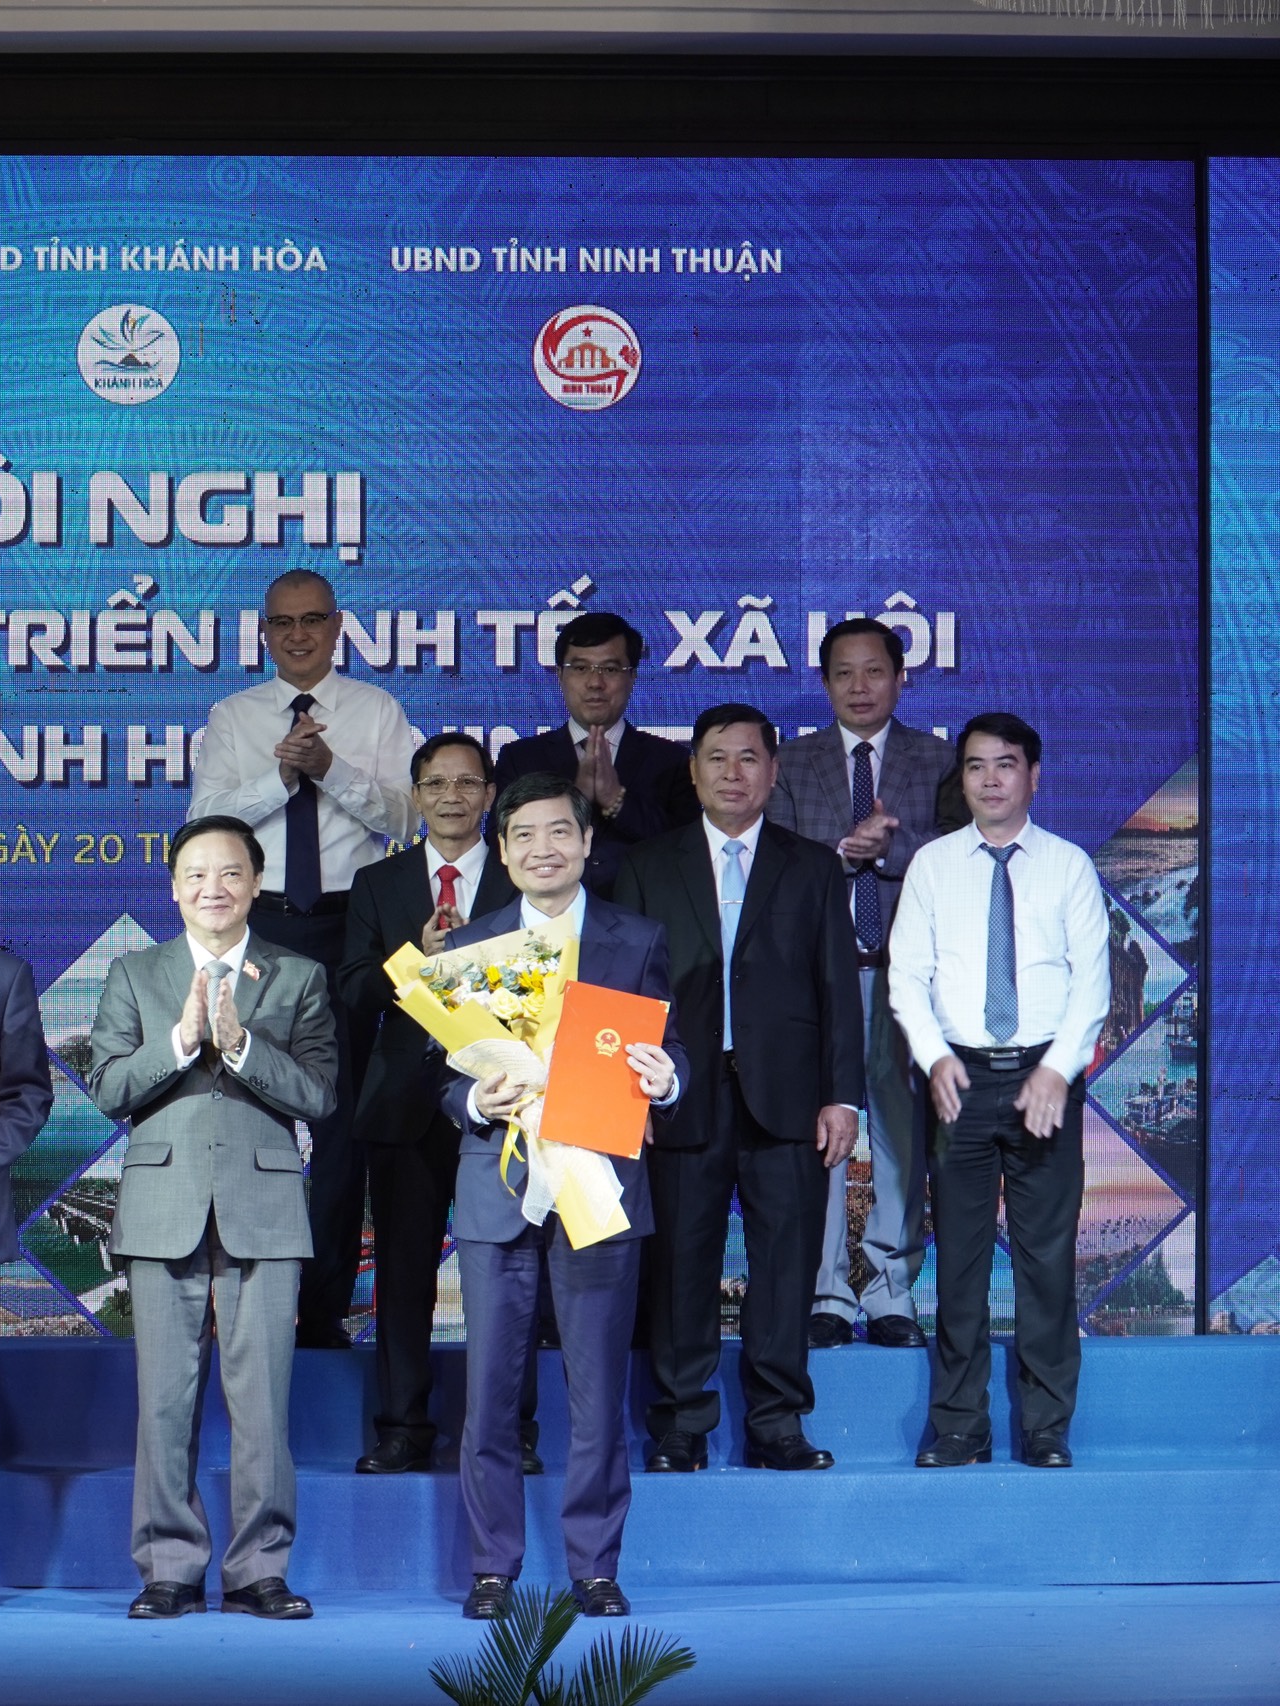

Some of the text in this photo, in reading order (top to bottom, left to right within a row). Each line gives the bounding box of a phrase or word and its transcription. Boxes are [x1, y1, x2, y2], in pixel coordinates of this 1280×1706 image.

[33, 237, 108, 272] TỈNH
[120, 238, 240, 272] KHÁNH
[252, 238, 327, 272] HÒA
[391, 237, 782, 281] UBND TỈNH NINH THUẬN
[89, 470, 362, 561] NGHỊ
[663, 594, 789, 667] XÃ
[73, 833, 124, 864] 20
